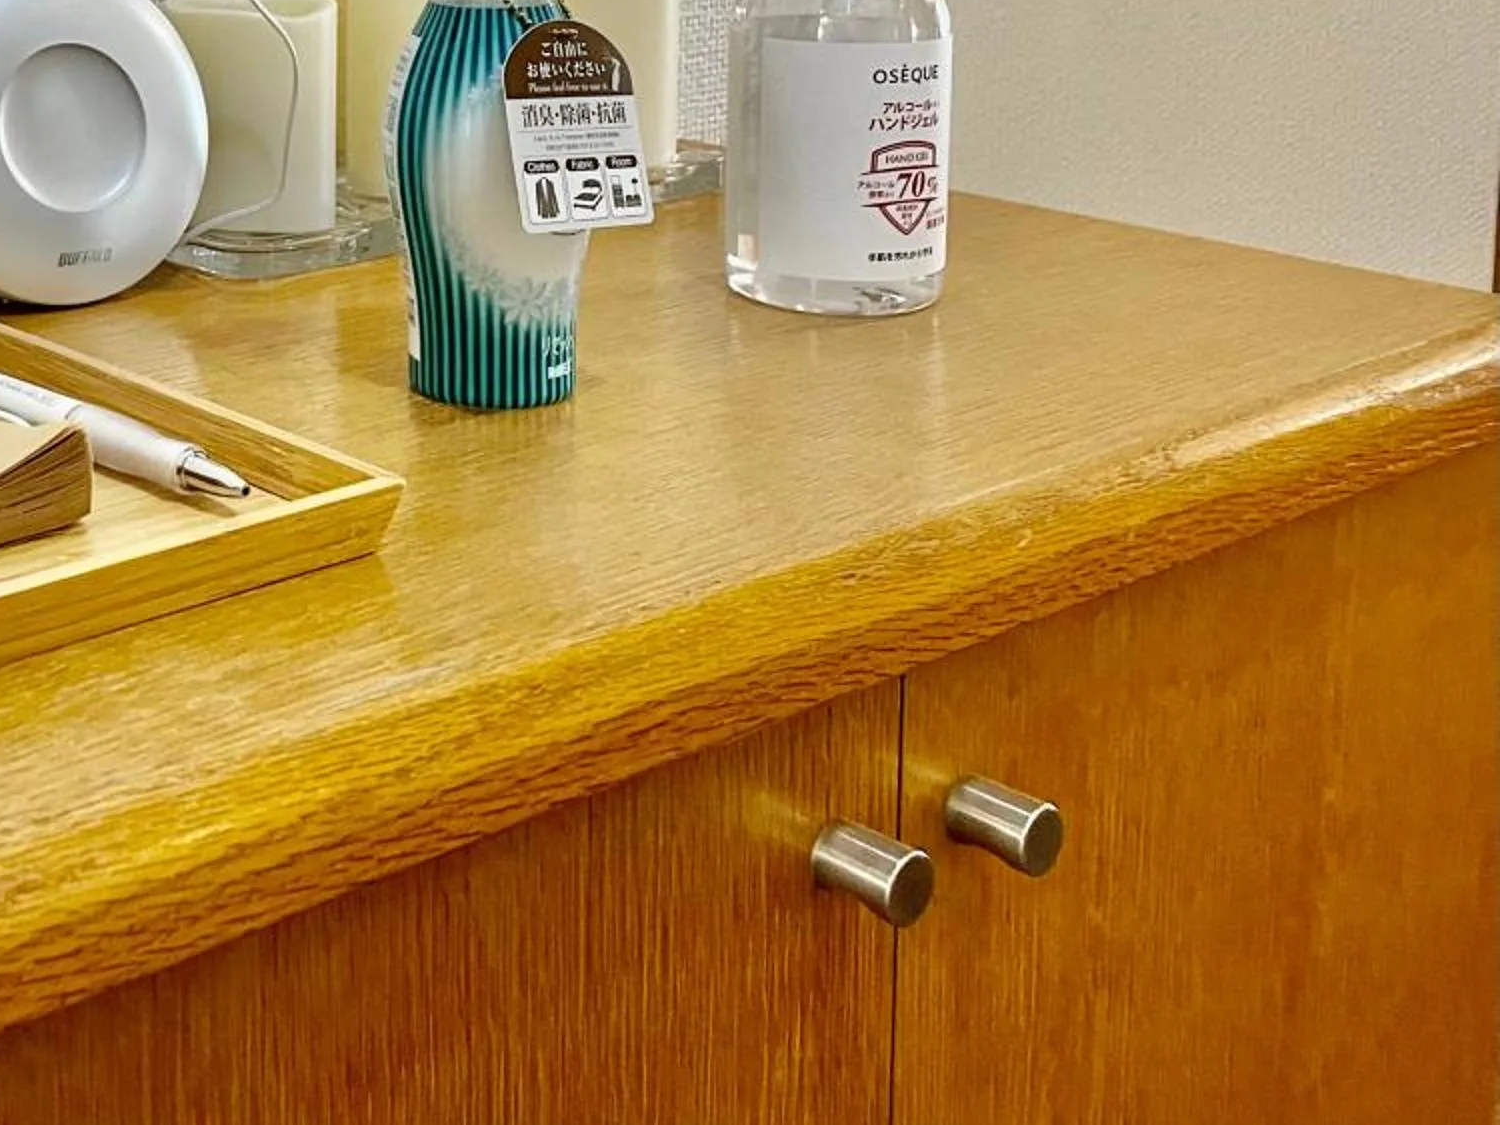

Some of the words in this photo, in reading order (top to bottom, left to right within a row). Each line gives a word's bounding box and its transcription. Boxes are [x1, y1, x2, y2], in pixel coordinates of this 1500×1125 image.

[541, 40, 588, 57] ご自由に
[527, 61, 606, 79] お使いください
[869, 111, 938, 131] ハンドジェル
